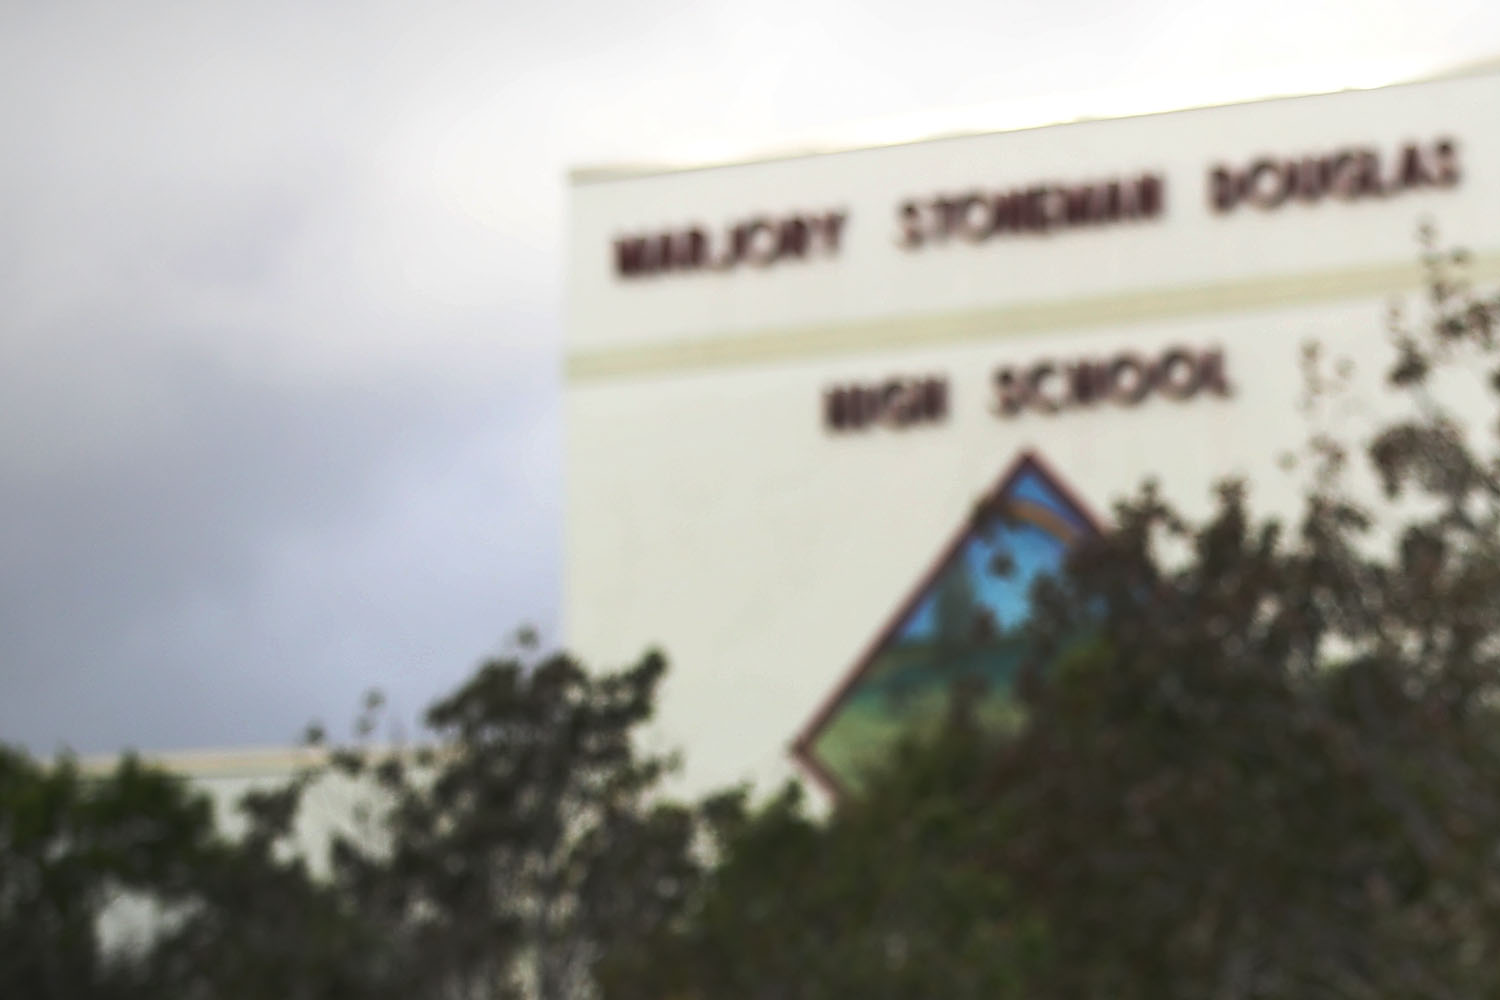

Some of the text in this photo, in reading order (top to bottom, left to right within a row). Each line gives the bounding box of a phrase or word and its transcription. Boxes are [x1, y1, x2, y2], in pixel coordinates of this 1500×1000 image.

[614, 207, 848, 276] MARJORY
[1209, 139, 1459, 214] DOUGLAS
[824, 347, 1234, 431] HIGH SCHOOL
